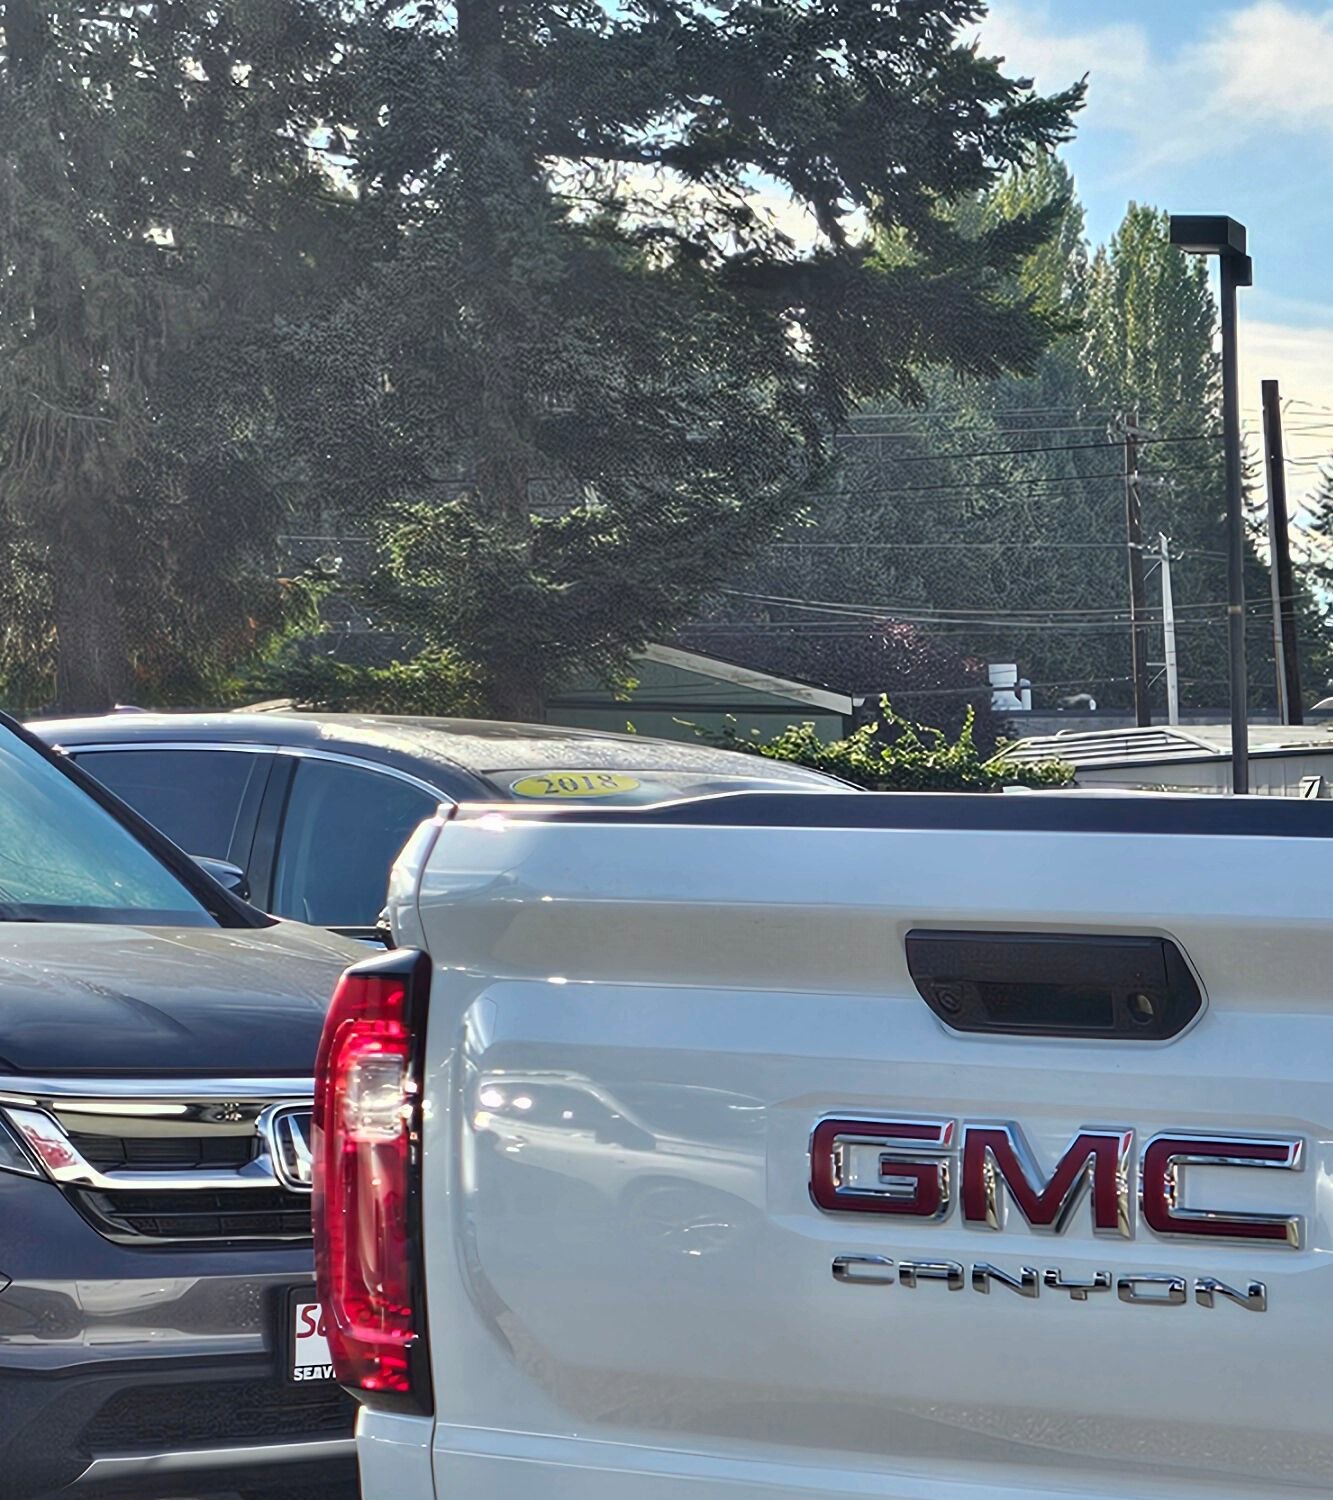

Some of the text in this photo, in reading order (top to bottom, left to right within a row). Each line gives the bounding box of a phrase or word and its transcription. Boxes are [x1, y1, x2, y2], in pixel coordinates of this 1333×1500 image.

[537, 774, 618, 794] 2018
[808, 1111, 1305, 1249] GMC
[832, 1255, 1267, 1312] CANYON
